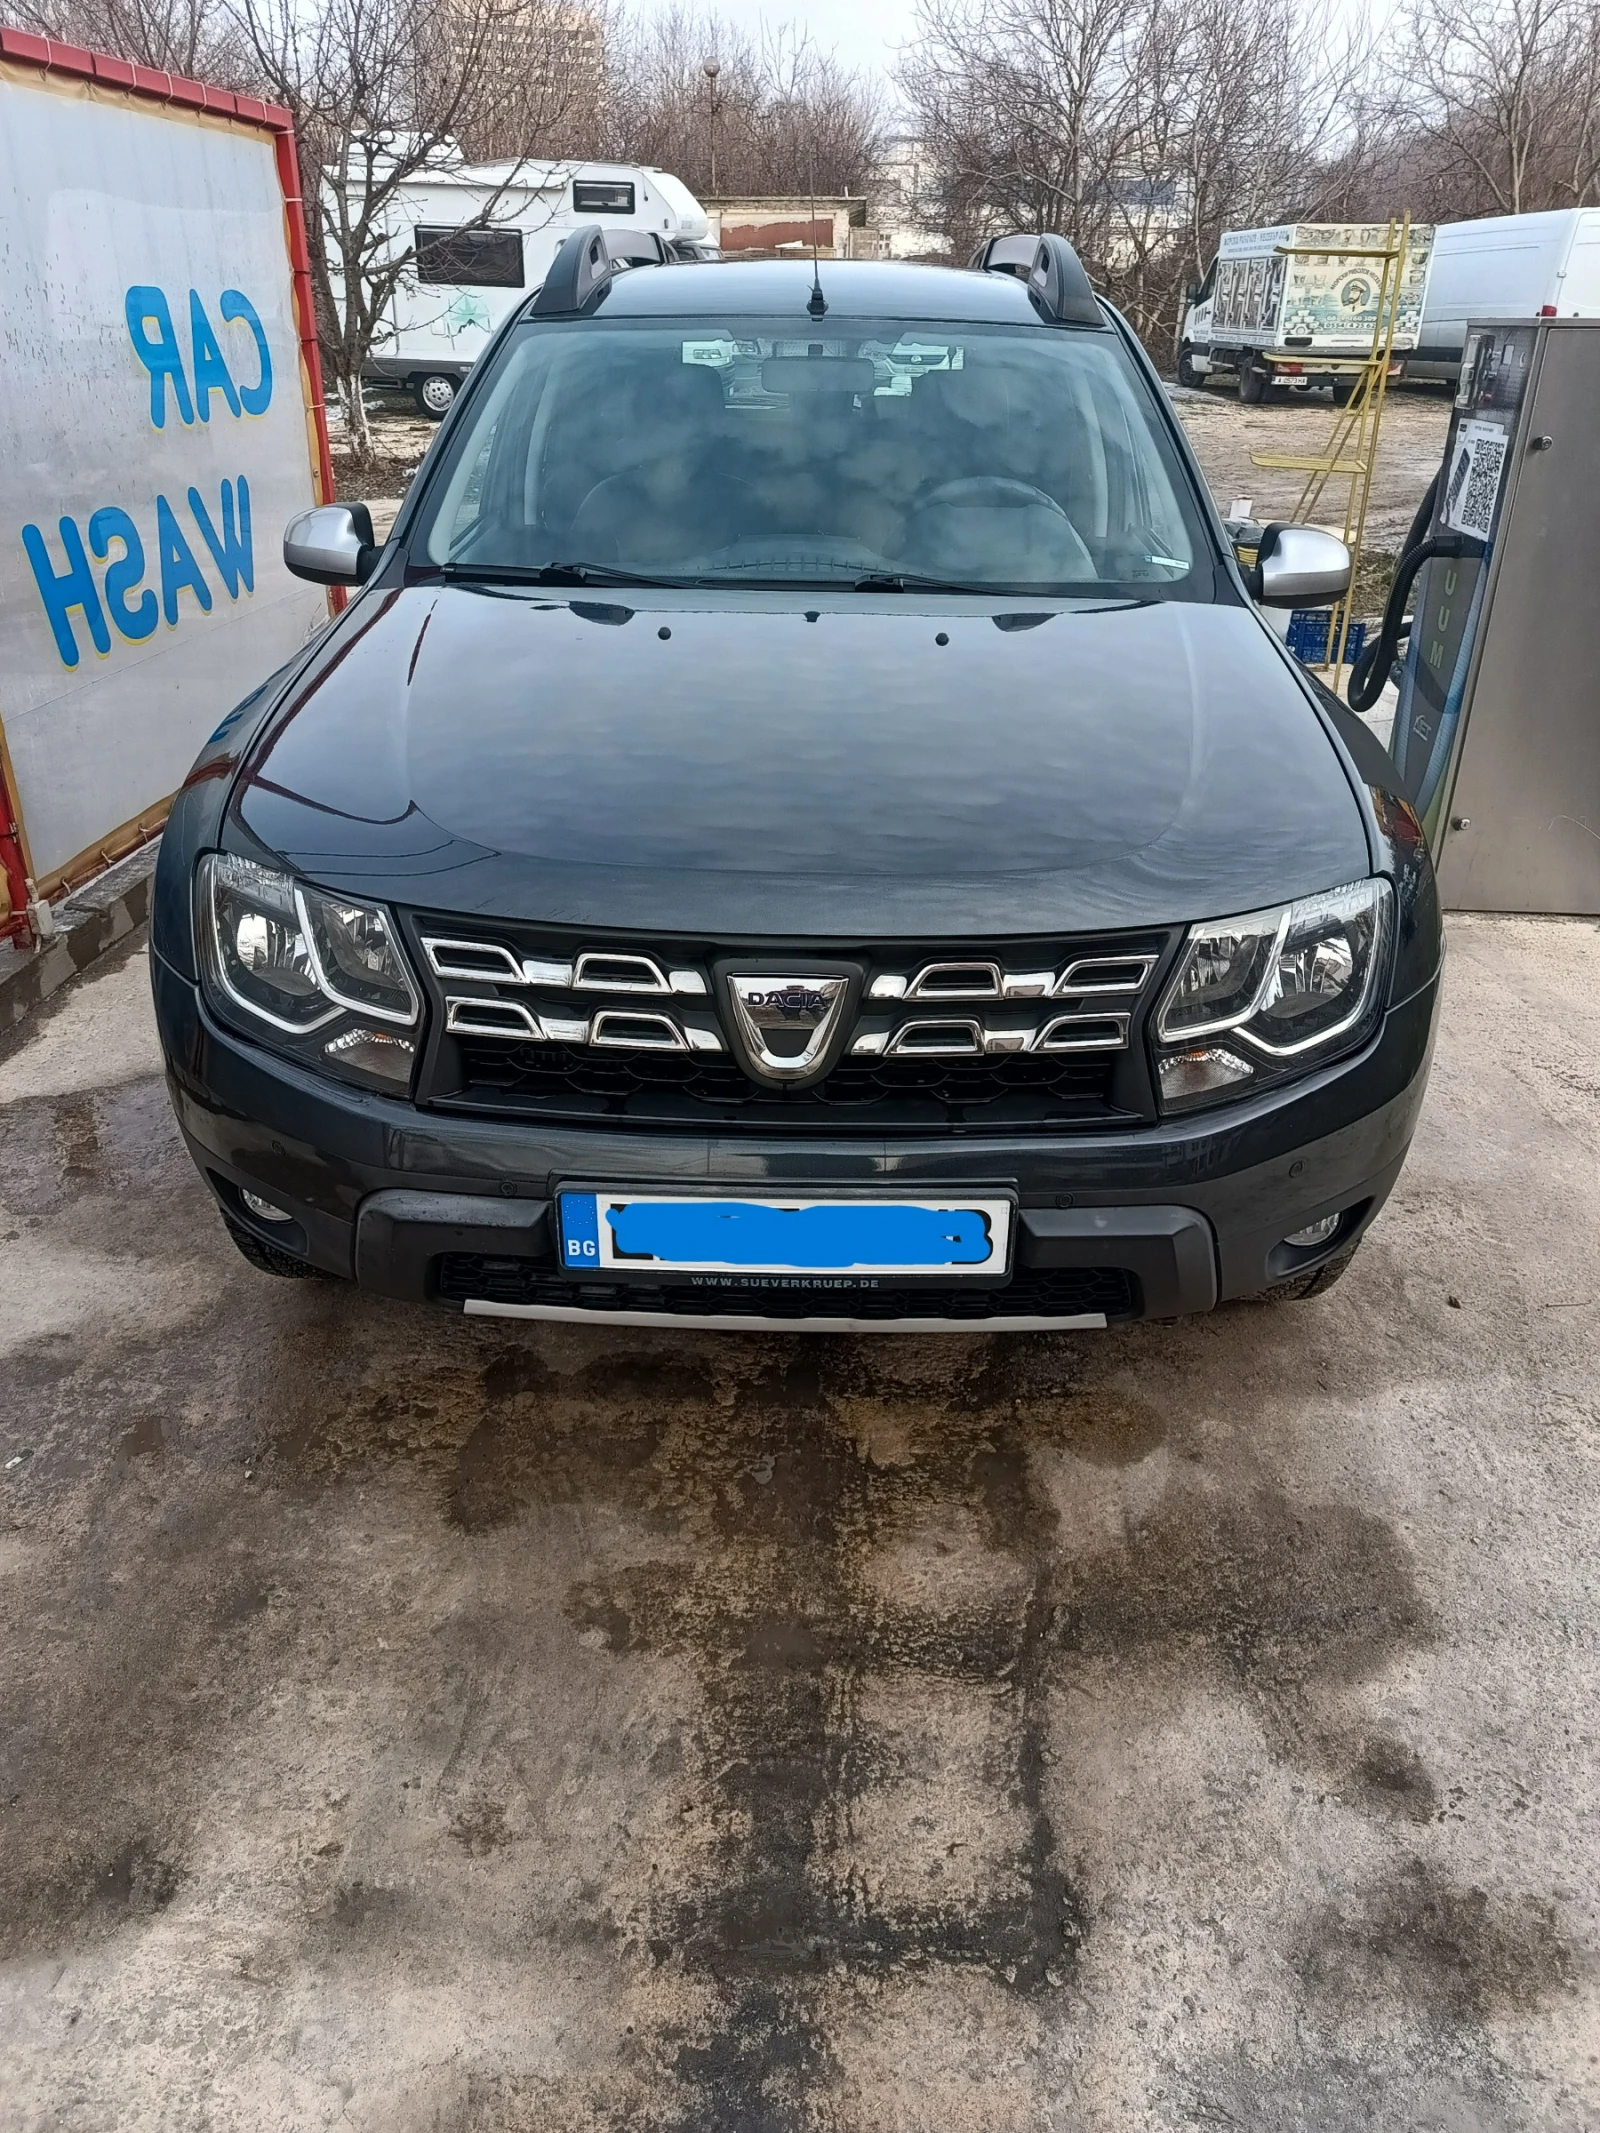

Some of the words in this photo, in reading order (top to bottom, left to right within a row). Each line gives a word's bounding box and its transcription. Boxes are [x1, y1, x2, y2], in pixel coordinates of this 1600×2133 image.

[747, 992, 826, 1008] DACIA
[567, 1239, 596, 1257] BG
[691, 1276, 879, 1288] WWW.SUEVERKRUEP.DE
